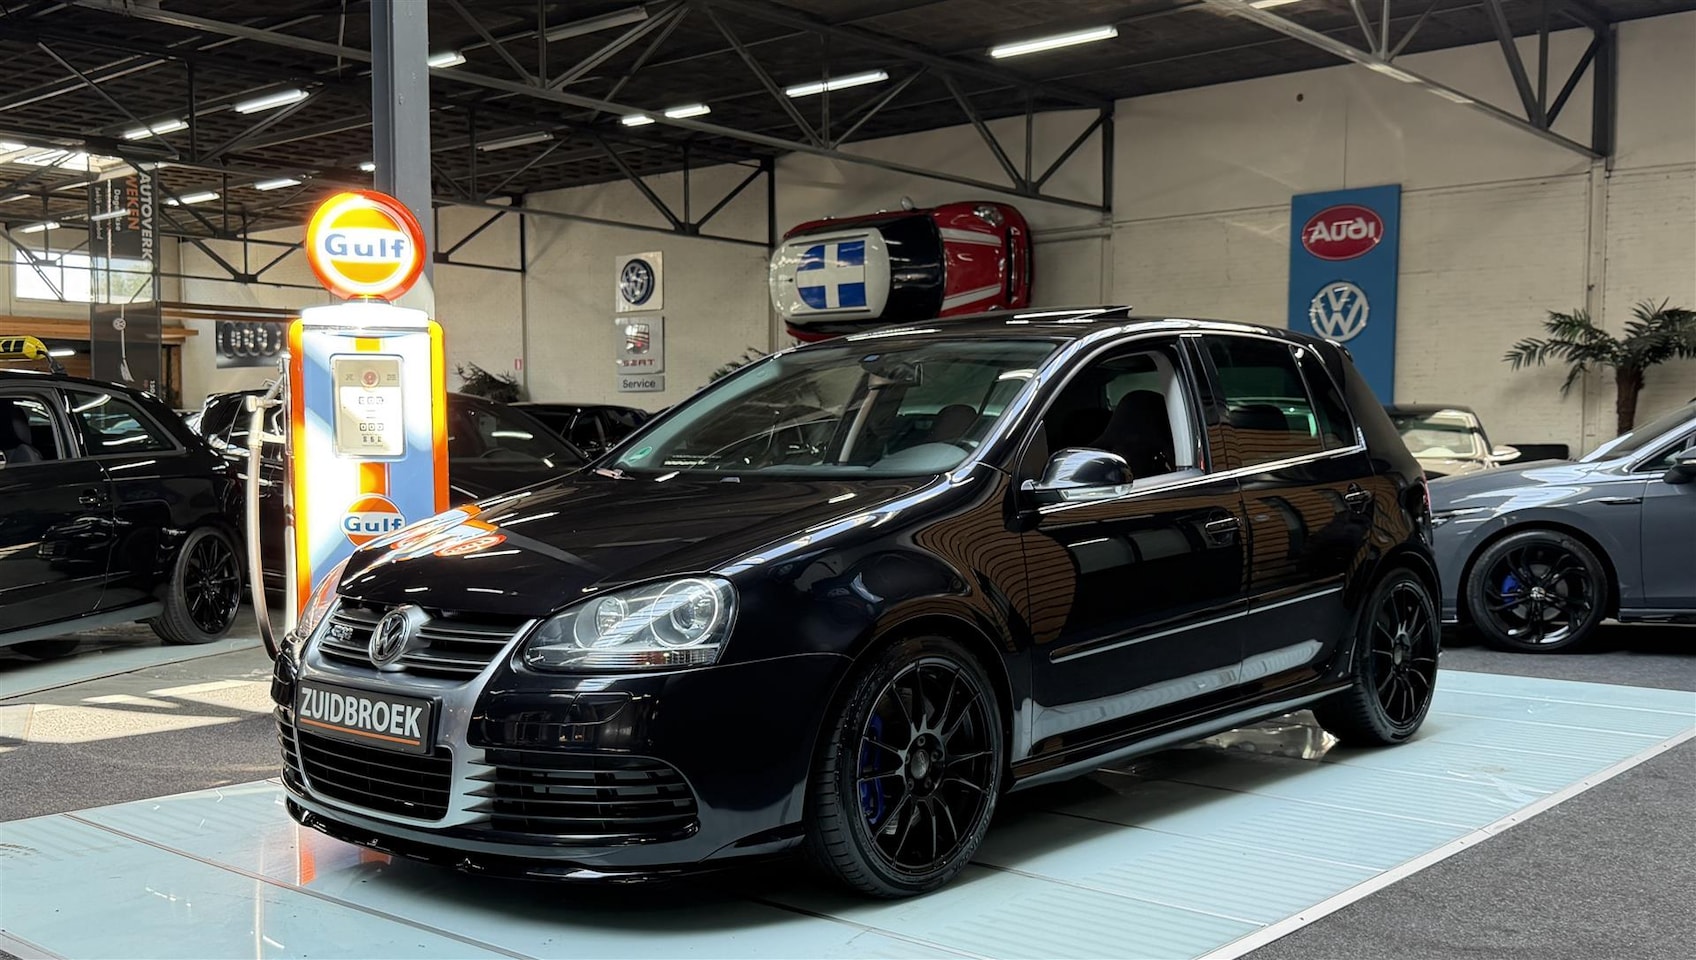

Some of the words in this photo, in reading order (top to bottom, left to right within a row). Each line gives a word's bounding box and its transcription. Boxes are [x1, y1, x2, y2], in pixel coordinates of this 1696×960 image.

[324, 233, 405, 258] Gulf
[622, 379, 656, 389] Service
[344, 516, 403, 532] Gulf
[300, 687, 423, 739] ZUIDBROEK
